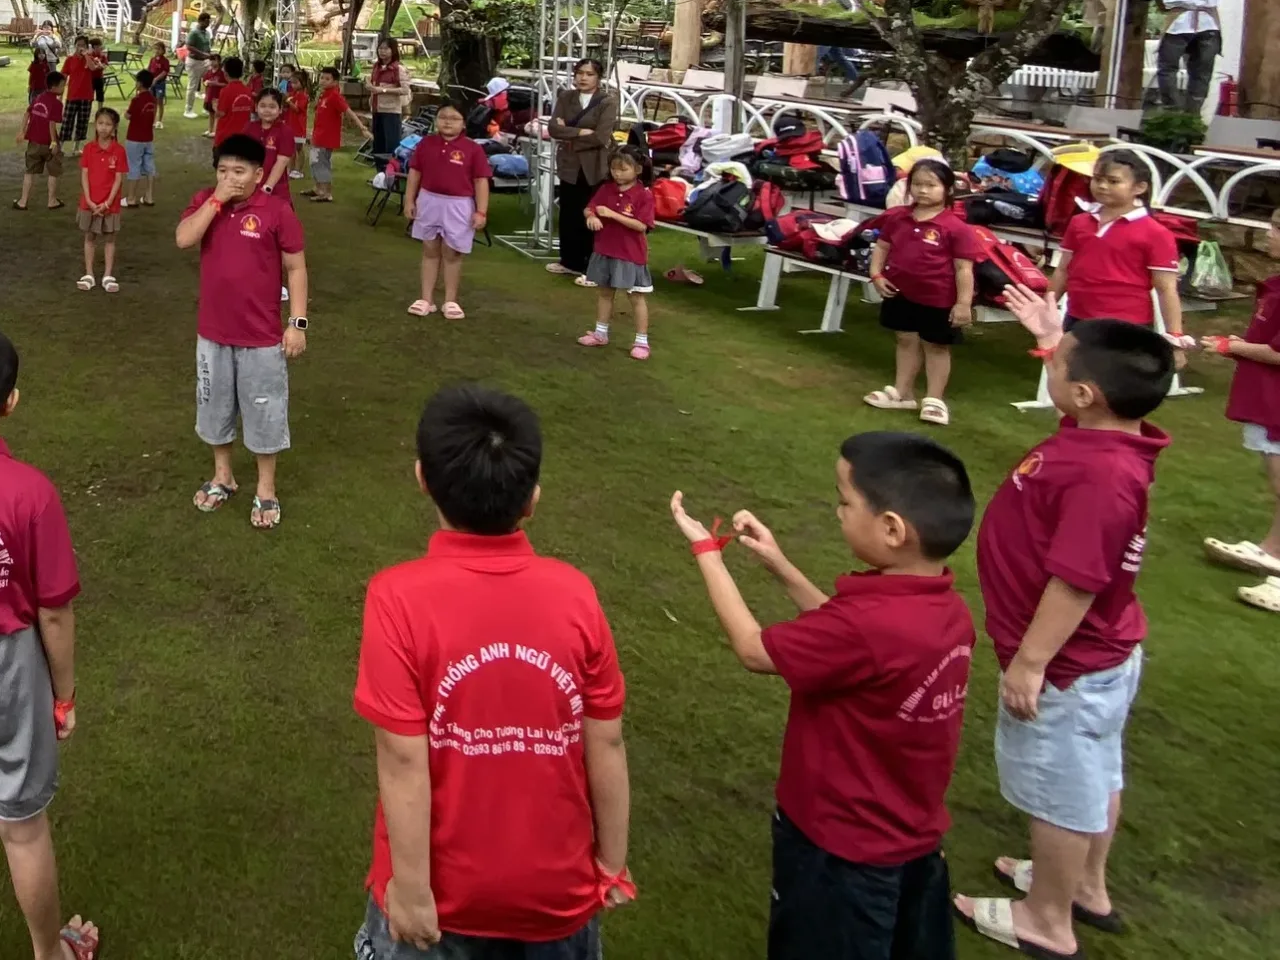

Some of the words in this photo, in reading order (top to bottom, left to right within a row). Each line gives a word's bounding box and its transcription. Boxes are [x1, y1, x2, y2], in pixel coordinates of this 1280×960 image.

[438, 654, 480, 698] THỐNG
[480, 642, 510, 664] ANH
[515, 644, 551, 670] NGỮ
[550, 662, 577, 695] VIỆT
[474, 727, 494, 740] Cho
[495, 726, 524, 739] Tương
[527, 727, 543, 739] Lai
[462, 743, 490, 756] 02693
[491, 741, 511, 755] 8616
[513, 740, 525, 752] 89
[534, 743, 564, 757] 02693
